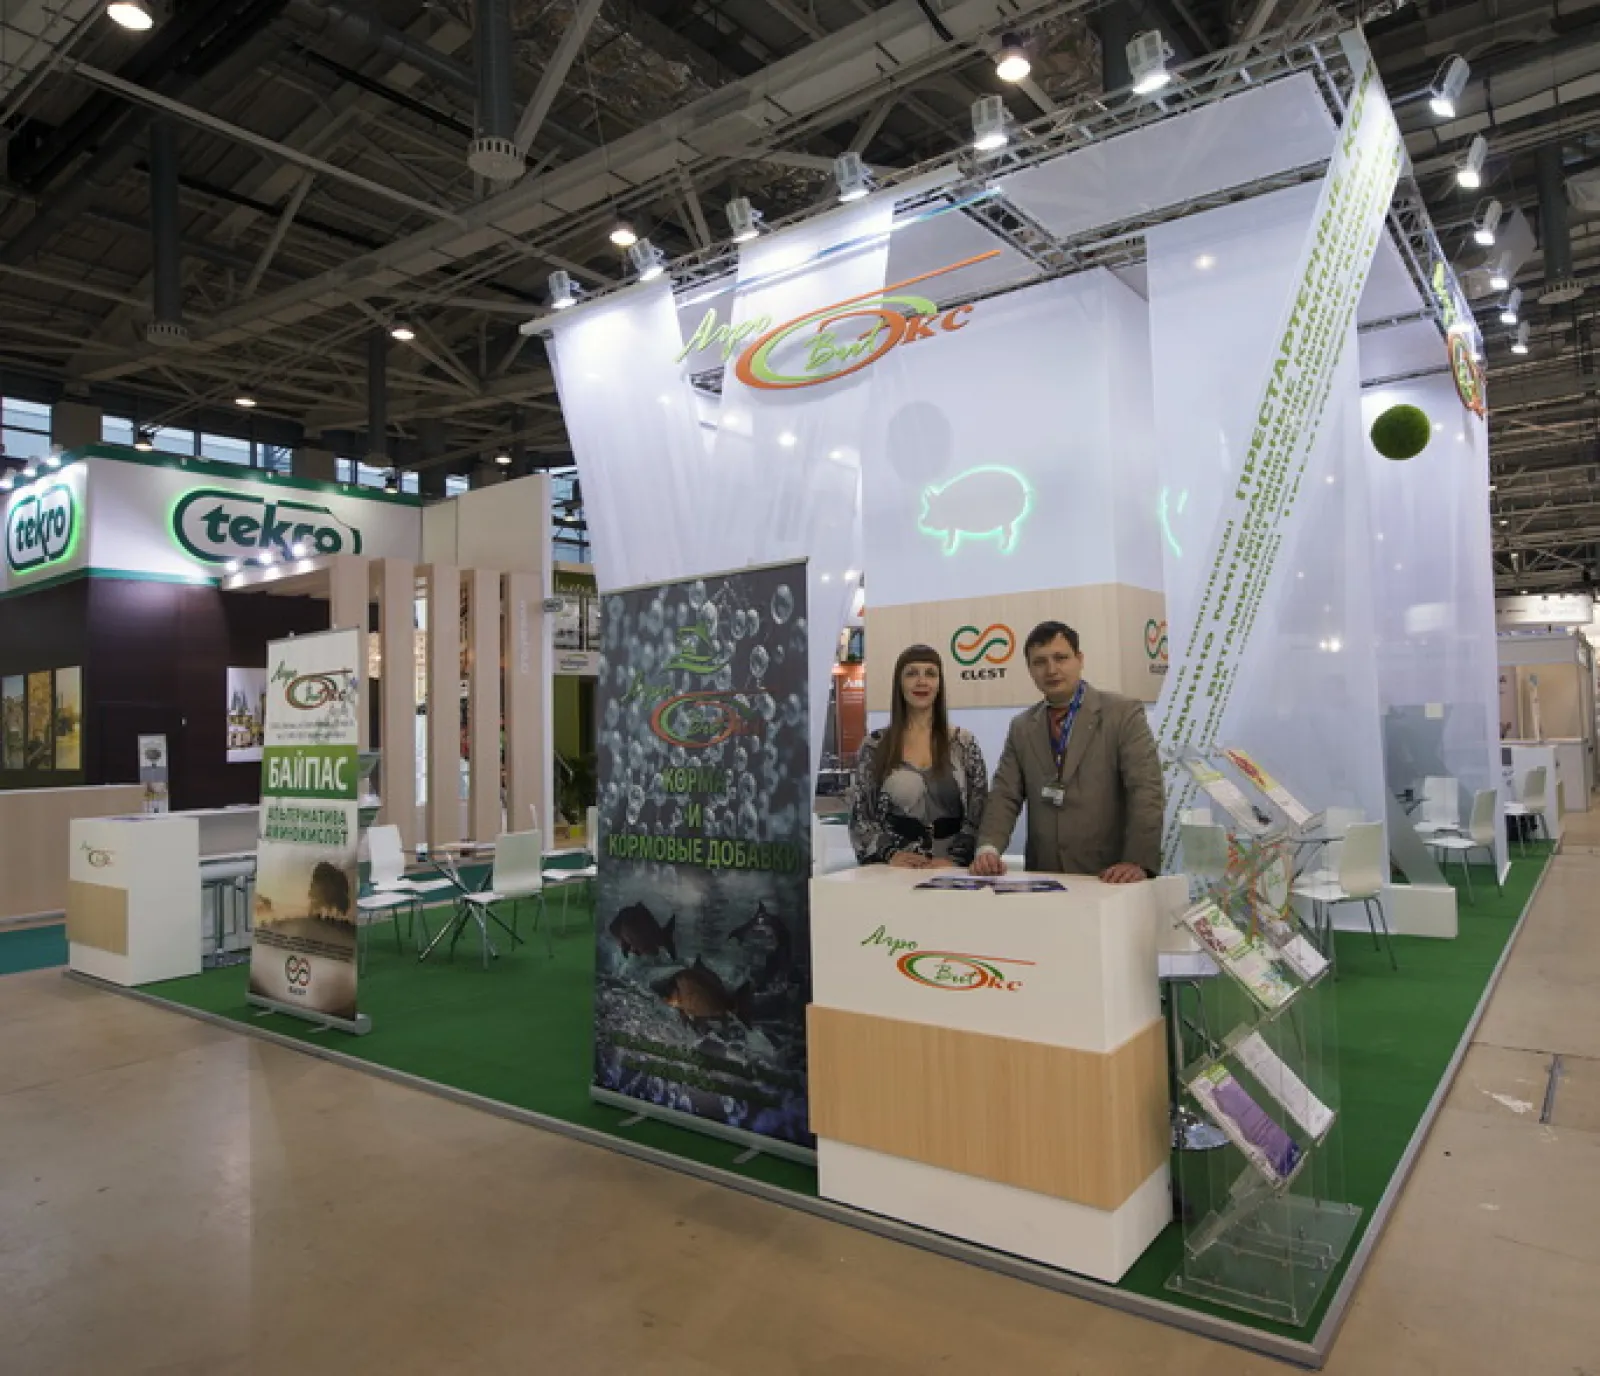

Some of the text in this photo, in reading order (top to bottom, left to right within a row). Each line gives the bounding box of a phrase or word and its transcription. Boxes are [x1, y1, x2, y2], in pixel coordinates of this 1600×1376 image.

[15, 497, 66, 555] tekro
[201, 503, 343, 557] tekro
[268, 750, 349, 790] БАЙПАС
[687, 803, 703, 828] И
[608, 832, 801, 872] КОРМОВЫЕ ДОБАВКИ
